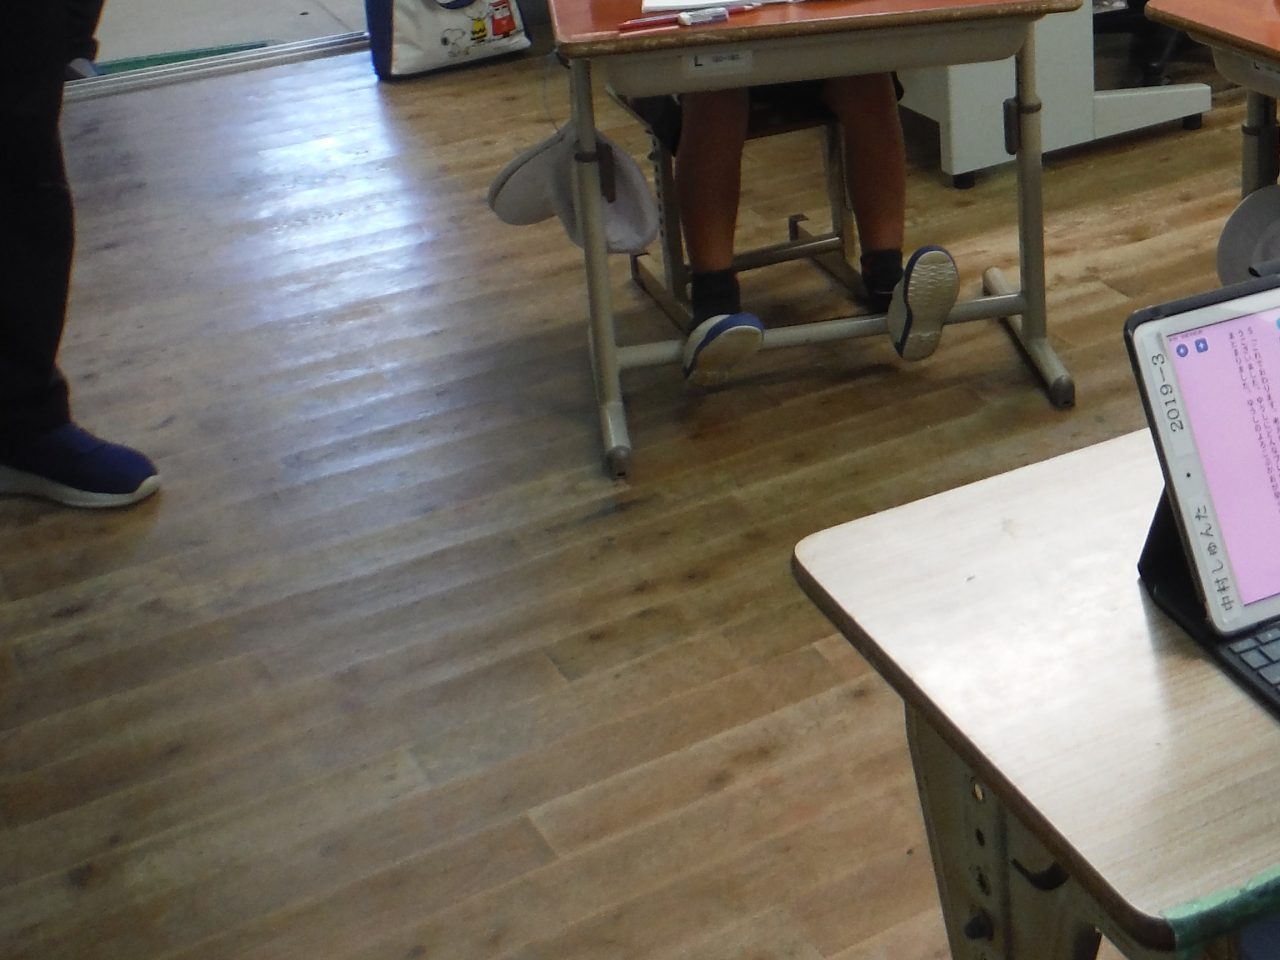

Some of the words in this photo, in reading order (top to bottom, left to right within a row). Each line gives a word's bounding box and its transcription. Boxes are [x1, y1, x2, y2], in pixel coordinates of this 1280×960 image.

[1195, 504, 1235, 611] 中村しゅんた
